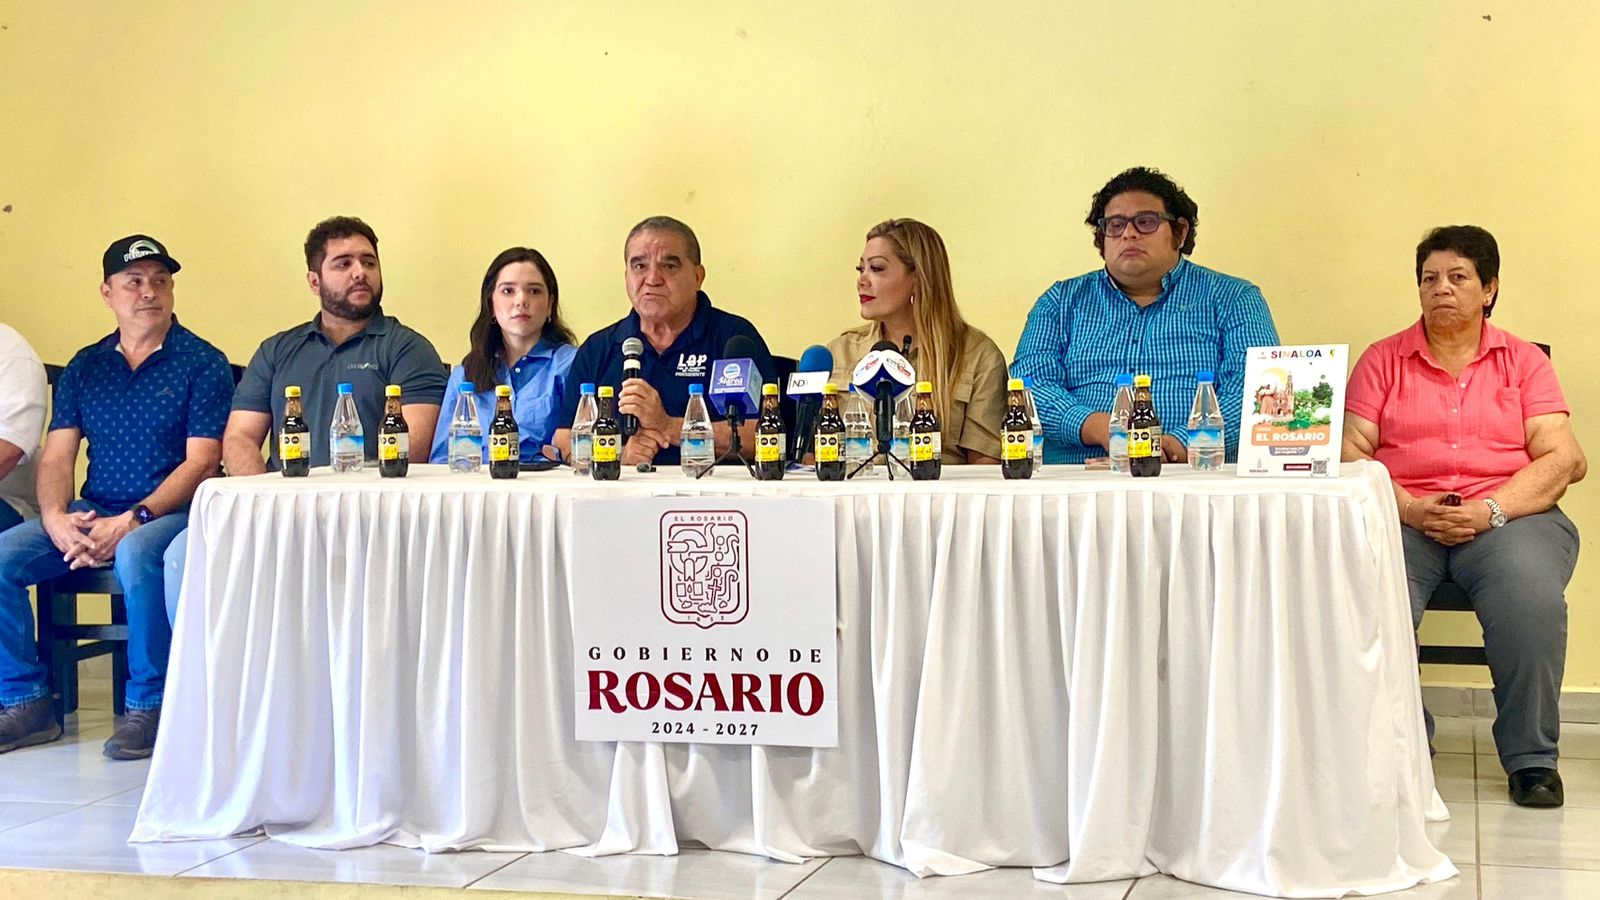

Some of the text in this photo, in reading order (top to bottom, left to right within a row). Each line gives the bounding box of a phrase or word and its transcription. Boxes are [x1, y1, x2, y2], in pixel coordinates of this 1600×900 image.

[1271, 349, 1322, 359] SINALOA
[1256, 432, 1325, 442] EL ROSARIO
[588, 646, 821, 663] GOBIERNO DE
[587, 670, 824, 716] ROSARIO
[652, 722, 695, 734] 2024
[716, 723, 759, 736] 2027
